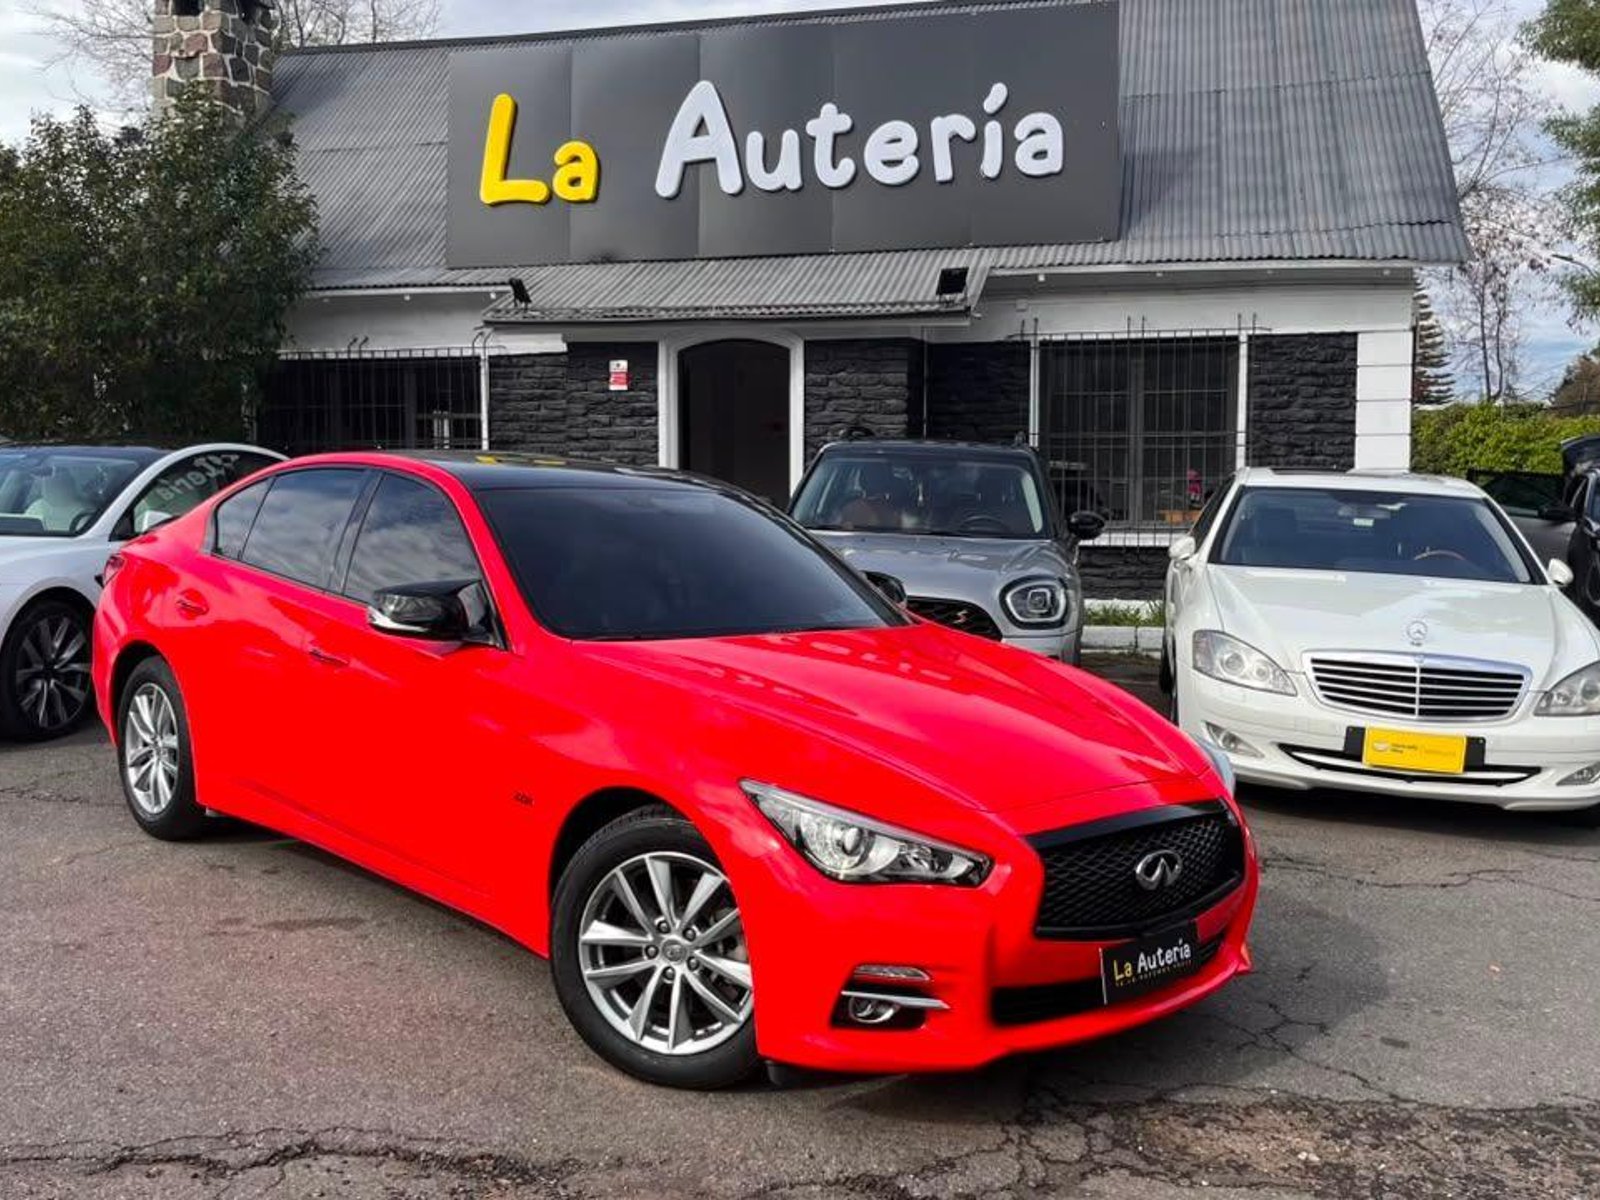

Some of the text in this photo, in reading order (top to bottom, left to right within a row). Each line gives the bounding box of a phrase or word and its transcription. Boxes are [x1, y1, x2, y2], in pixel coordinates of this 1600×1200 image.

[480, 79, 1064, 204] La Autería
[1114, 960, 1132, 980] La
[1137, 939, 1192, 973] Autería
